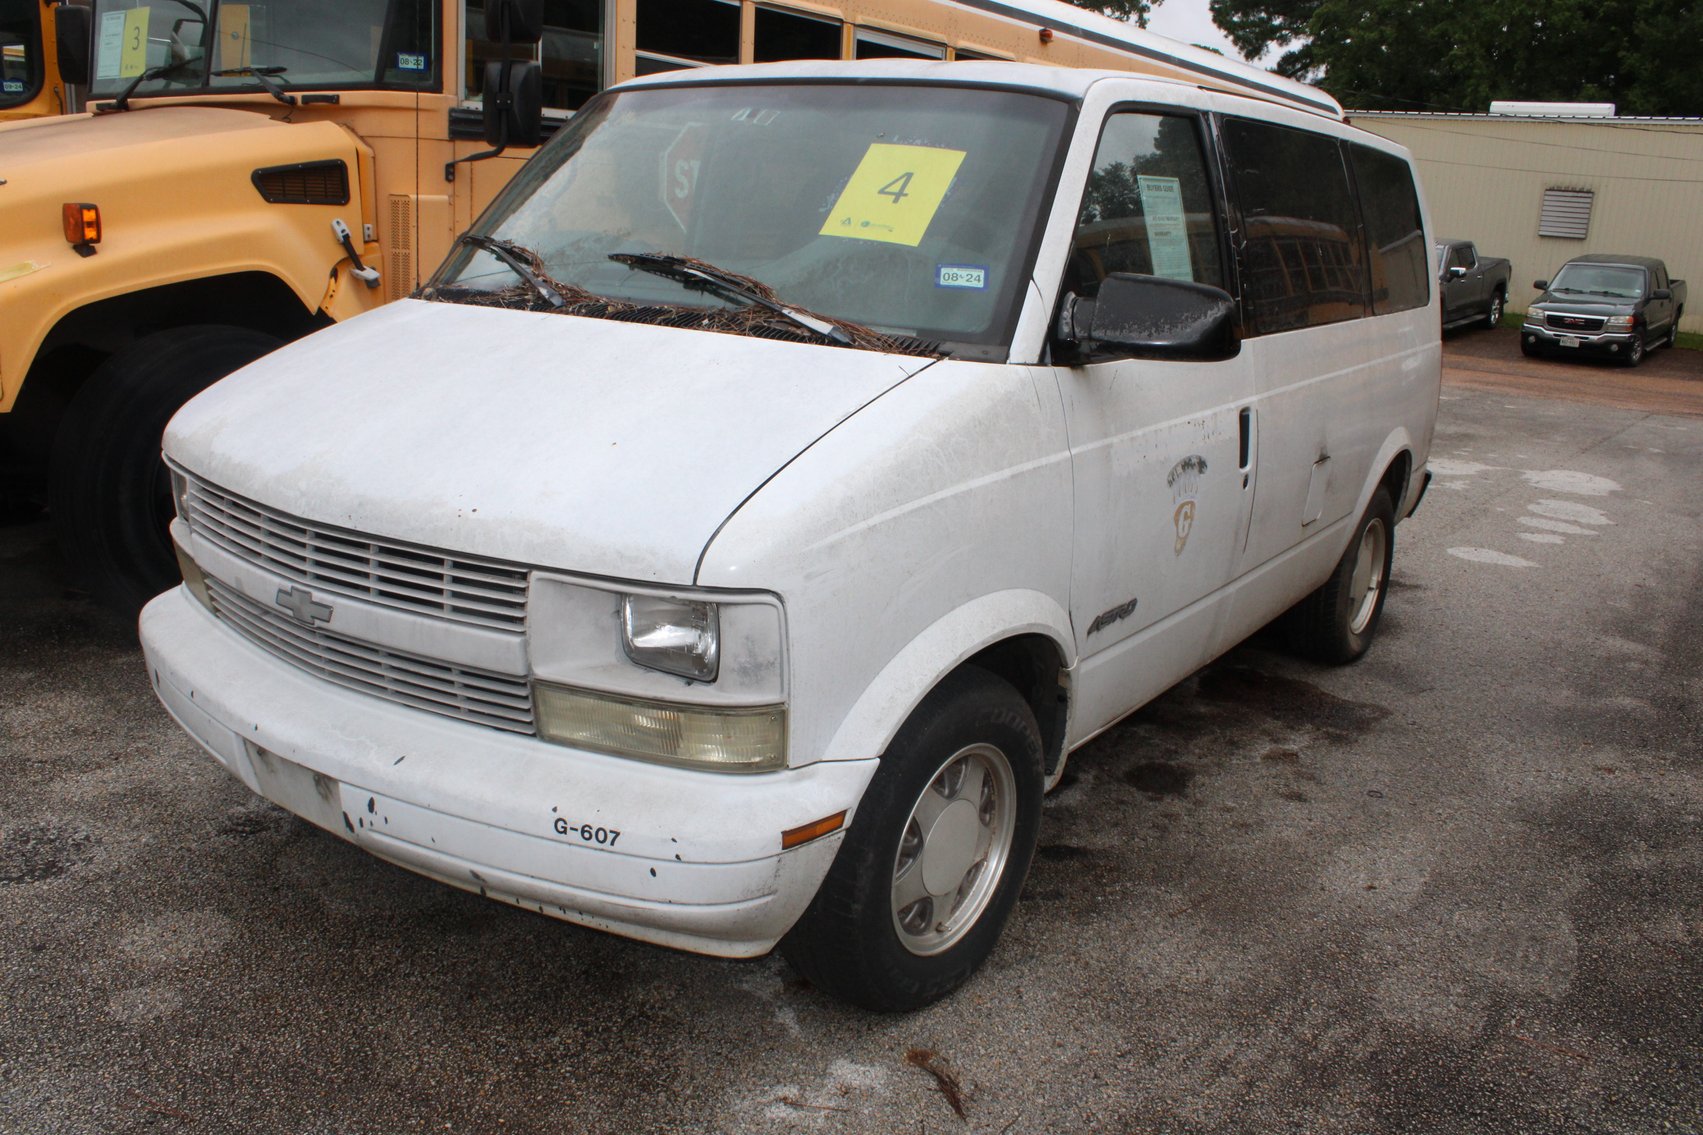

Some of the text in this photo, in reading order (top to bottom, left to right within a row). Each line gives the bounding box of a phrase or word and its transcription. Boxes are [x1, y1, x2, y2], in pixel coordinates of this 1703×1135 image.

[132, 26, 140, 50] 3
[675, 159, 701, 199] ST
[877, 171, 914, 204] 4
[943, 272, 981, 284] 08-24
[553, 817, 621, 847] G-607
